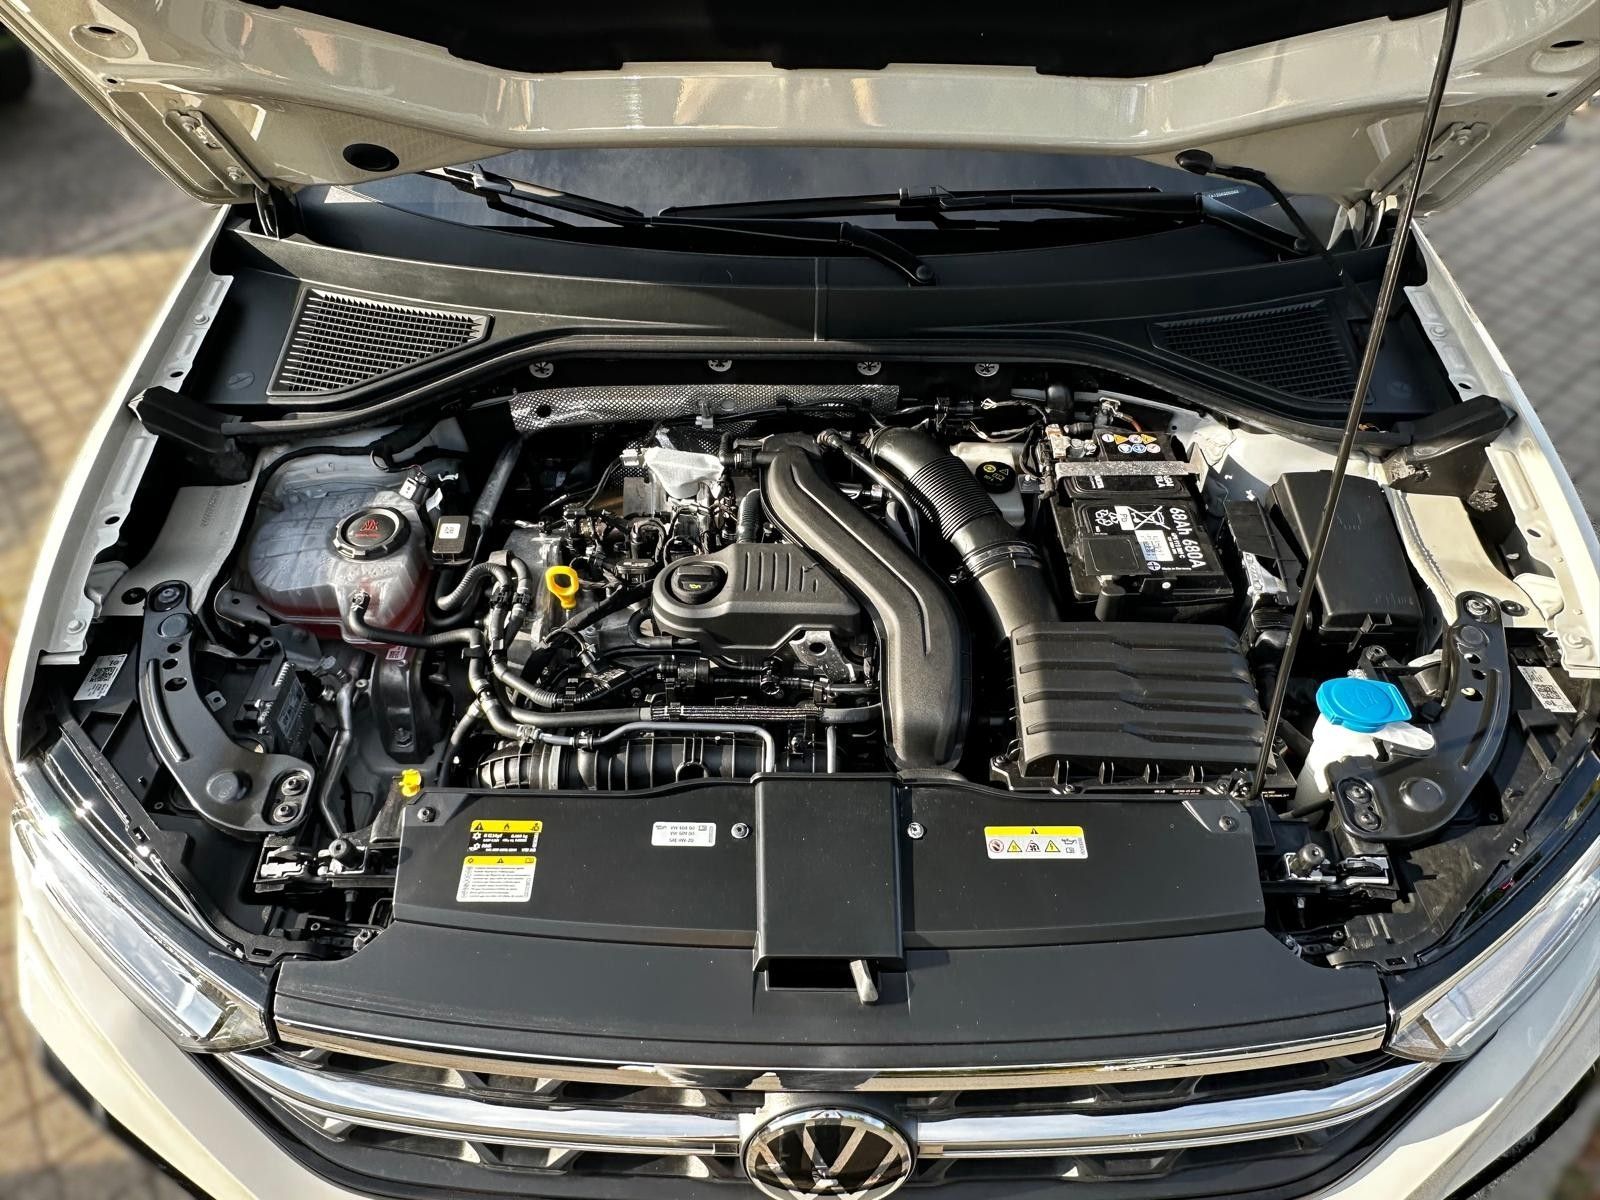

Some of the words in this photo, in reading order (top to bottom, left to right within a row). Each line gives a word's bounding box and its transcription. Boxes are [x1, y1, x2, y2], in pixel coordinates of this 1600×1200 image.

[1120, 513, 1128, 522] Pb
[1170, 507, 1193, 535] 68Ah
[1182, 539, 1207, 568] 680A
